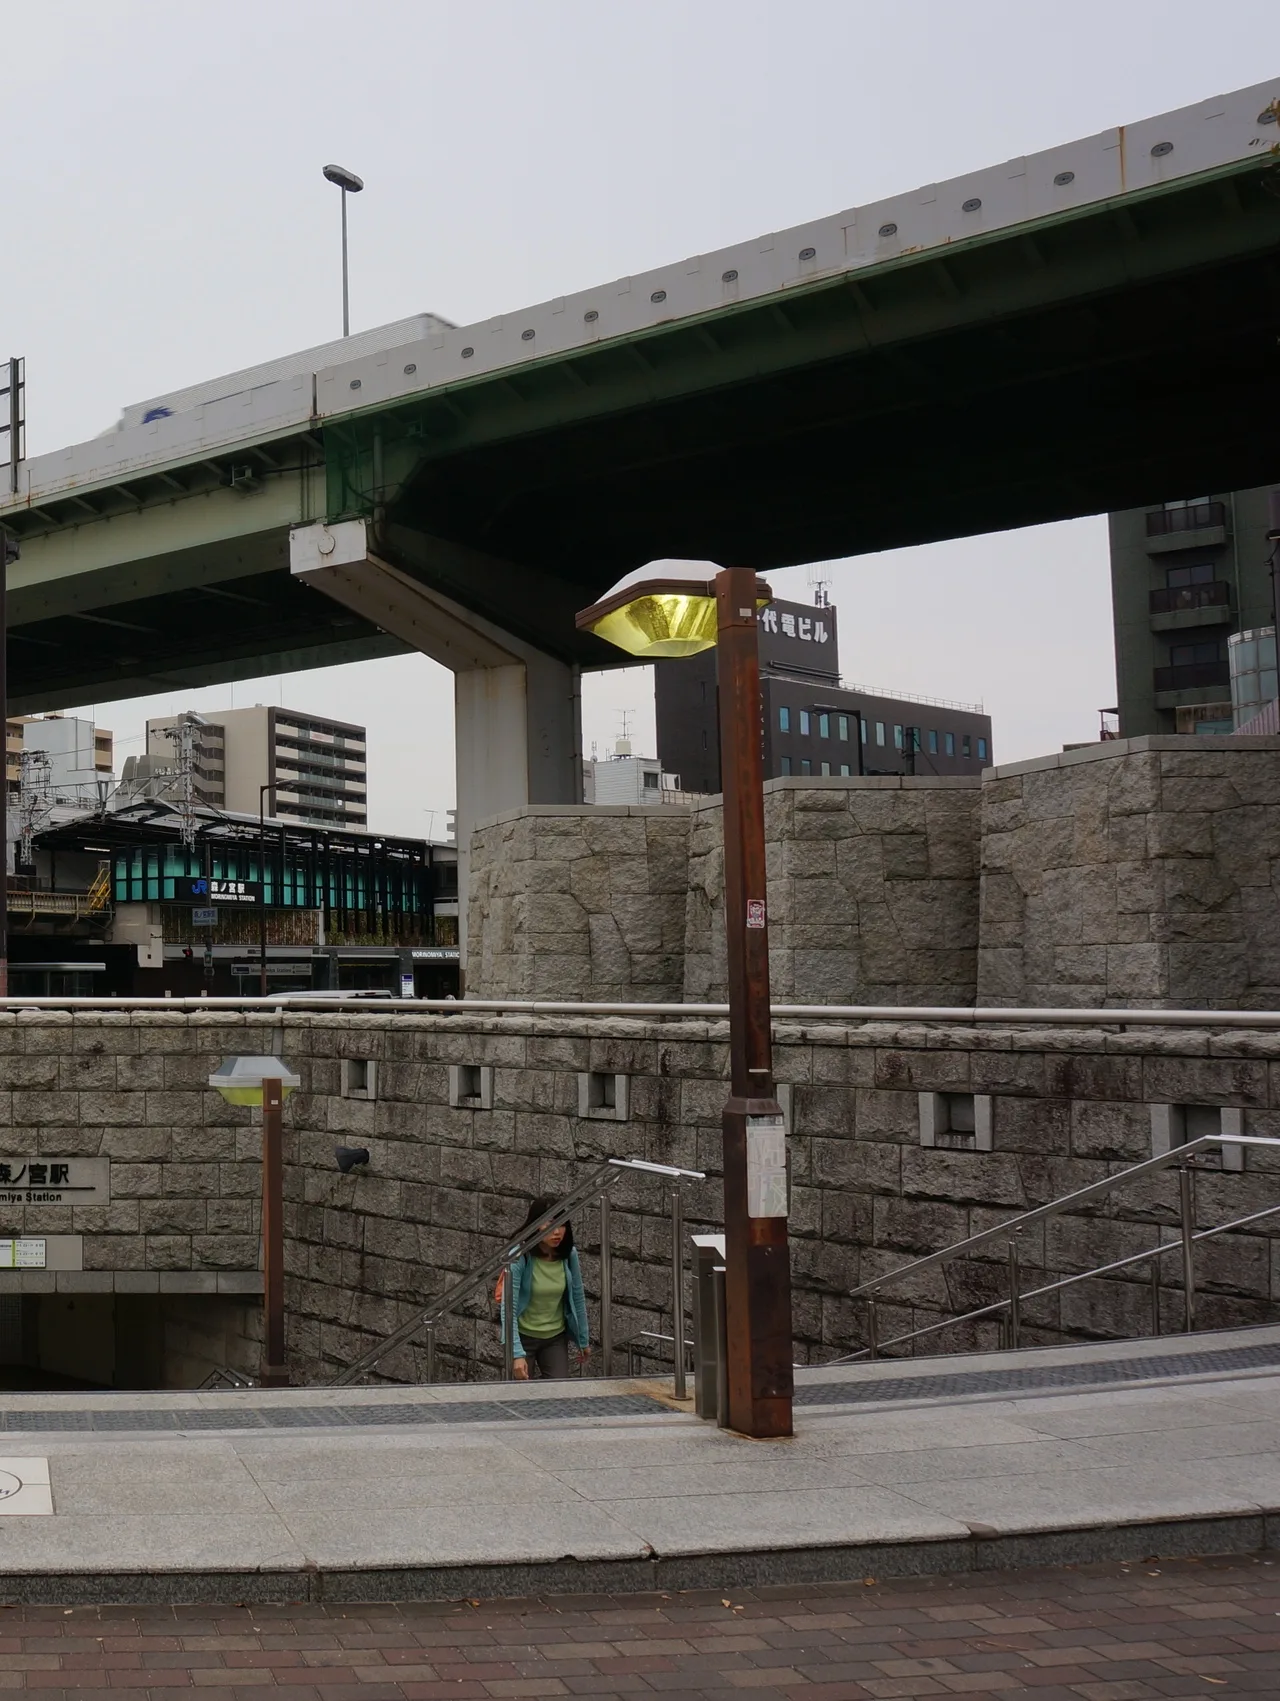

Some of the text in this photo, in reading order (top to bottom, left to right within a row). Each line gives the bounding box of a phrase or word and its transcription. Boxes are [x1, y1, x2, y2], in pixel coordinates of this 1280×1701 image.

[756, 608, 828, 643] 代電ビル
[192, 880, 208, 894] JR
[210, 881, 245, 894] 森ノ宮駅
[26, 1192, 62, 1202] Station
